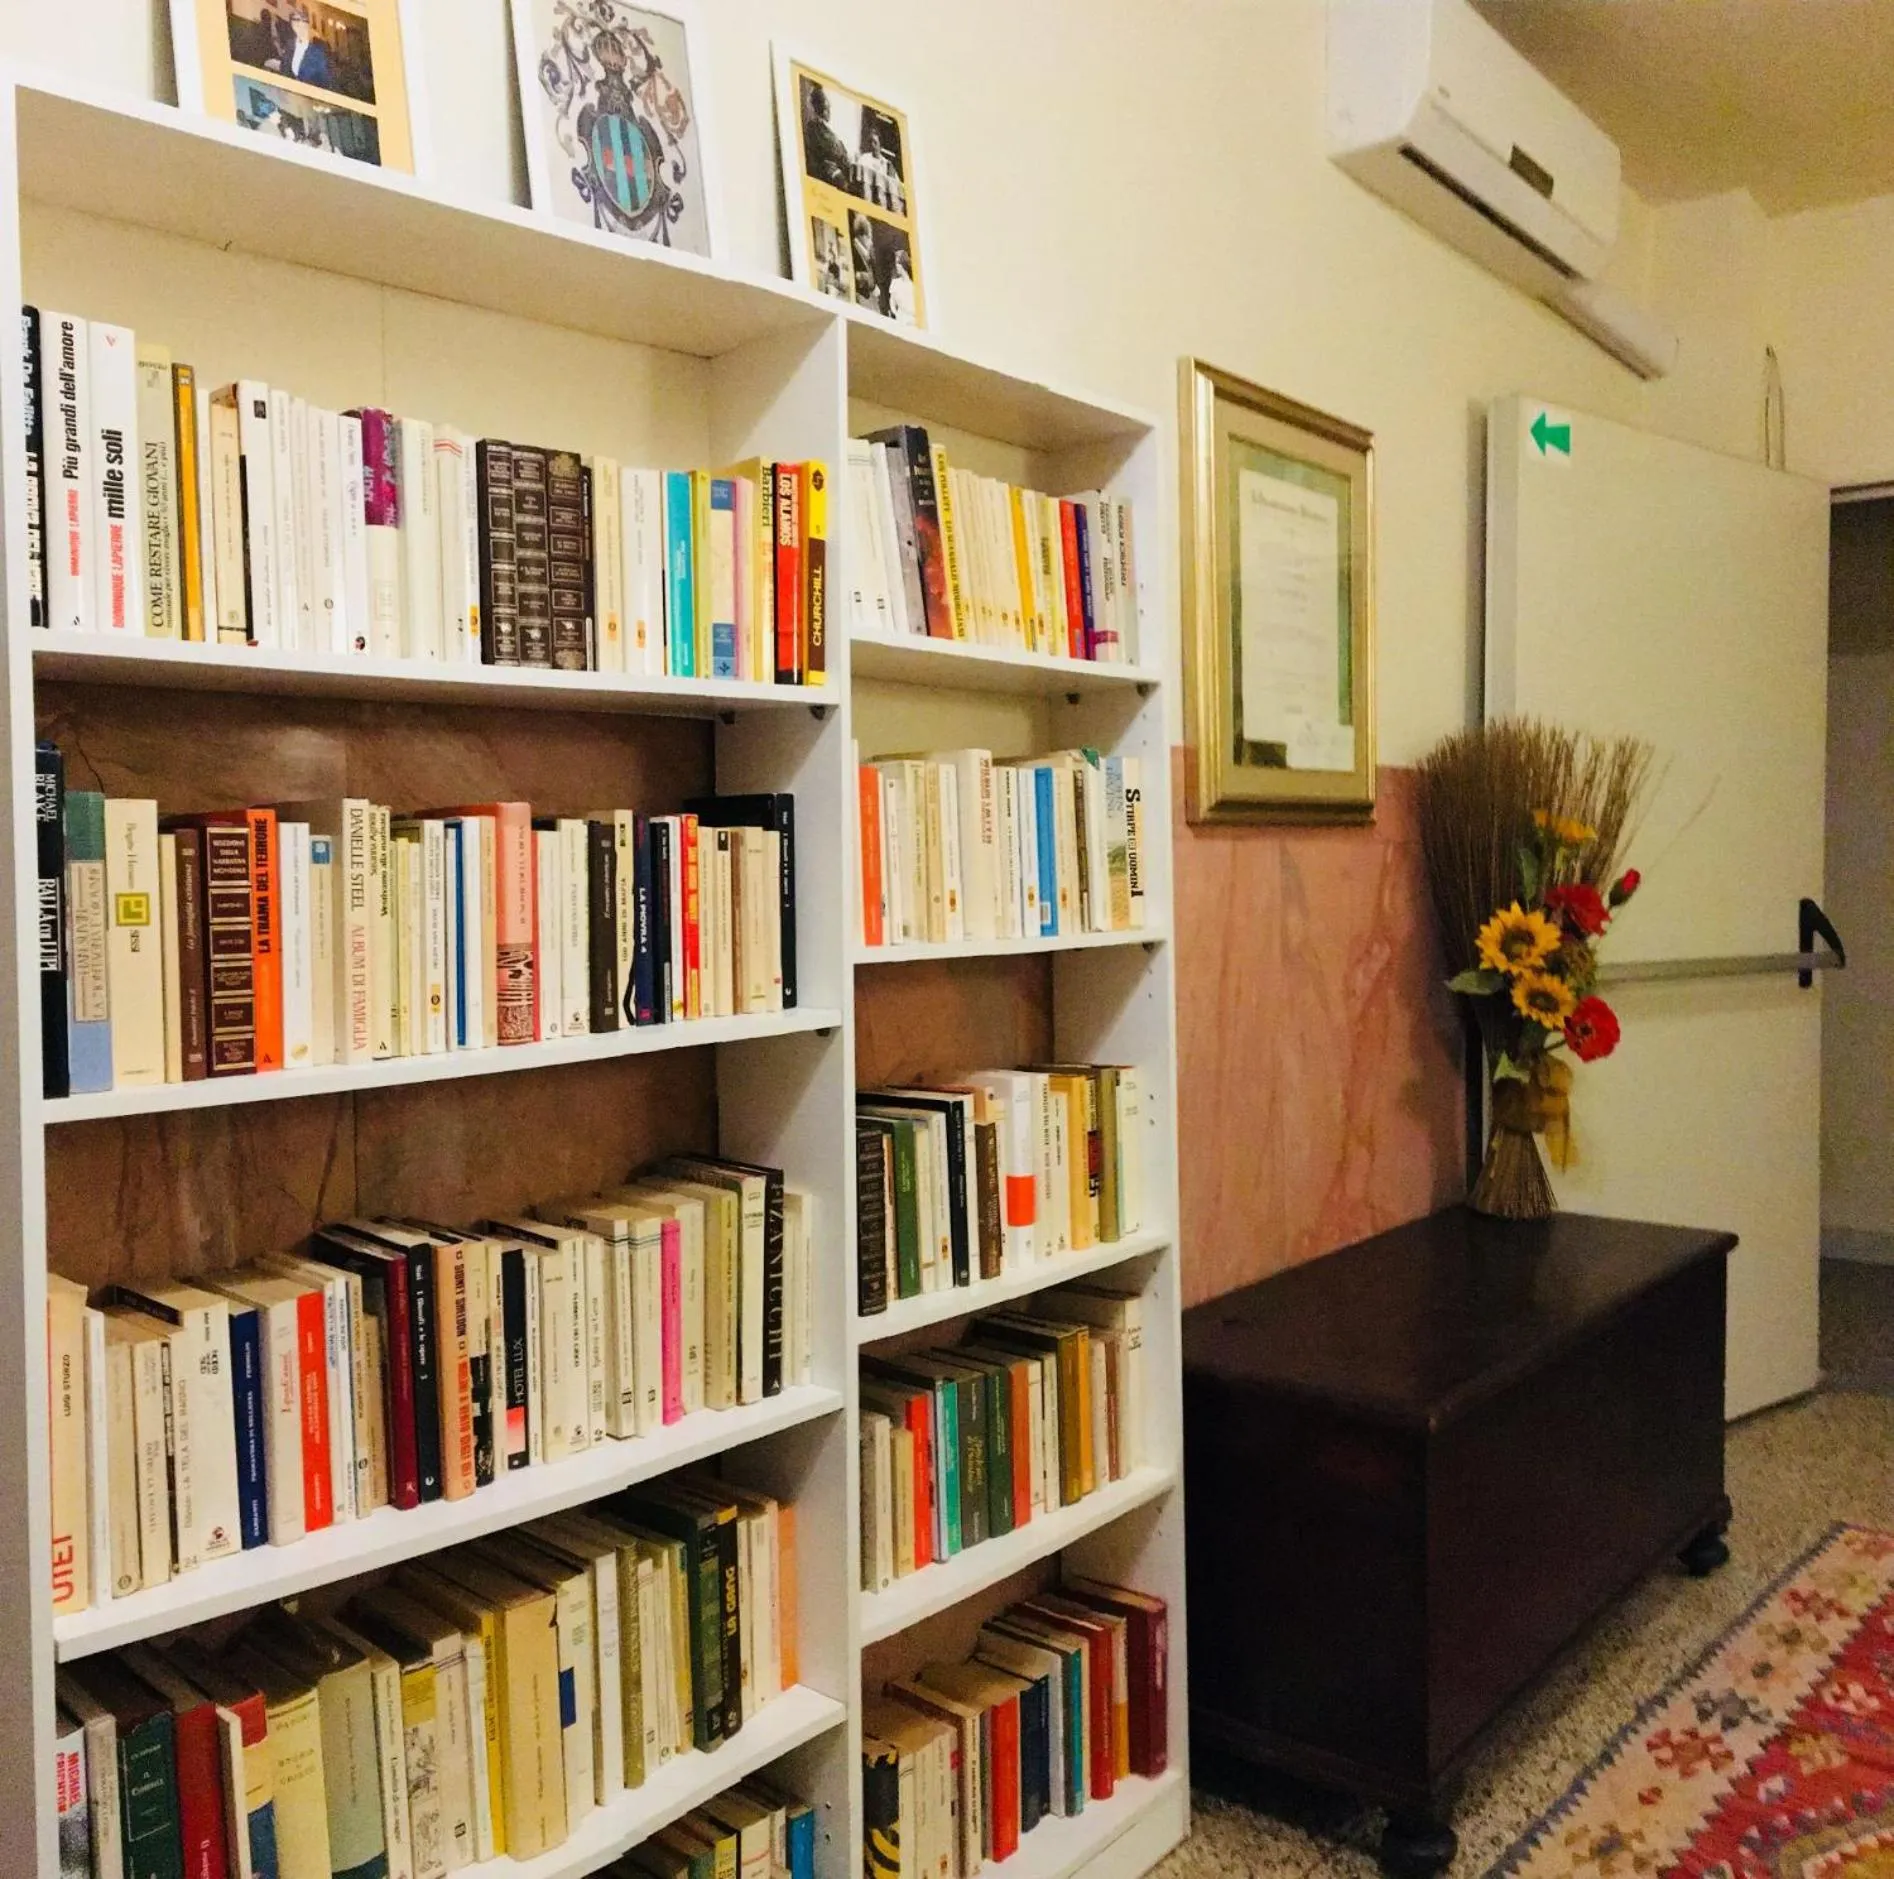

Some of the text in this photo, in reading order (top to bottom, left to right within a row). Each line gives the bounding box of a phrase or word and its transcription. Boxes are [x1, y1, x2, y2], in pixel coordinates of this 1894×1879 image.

[57, 321, 81, 480] Più grandi dell'amore
[101, 428, 125, 519] mille soli
[761, 466, 773, 528] Barbieri
[938, 474, 951, 513] FOLLETT
[145, 440, 164, 628] COME RESTARE GIOVANI
[779, 473, 793, 549] LOS ALAMOS
[110, 523, 125, 629] DOMINIQUE LAPIERRE
[812, 565, 823, 647] CHURCHILL
[44, 773, 57, 823] MICHAEL
[254, 817, 270, 954] LA TRAMA DEL TERRORE
[349, 808, 364, 912] DANIELLE STEEL
[1129, 851, 1144, 898] UOMINI
[38, 878, 57, 923] BALLA
[638, 887, 646, 903] LA
[639, 904, 647, 945] PIOVRA
[39, 940, 58, 972] LUPI
[351, 924, 367, 1052] ALBUM DI FAMIGLIA
[454, 1263, 467, 1337] SIDNEY SHELDON
[62, 1354, 72, 1417] LUIGI STURZO
[511, 1337, 524, 1404] HOTEL LUX
[52, 1534, 74, 1603] UTET
[55, 1751, 67, 1814] CRICHTON
[67, 1751, 81, 1808] MICHAEL
